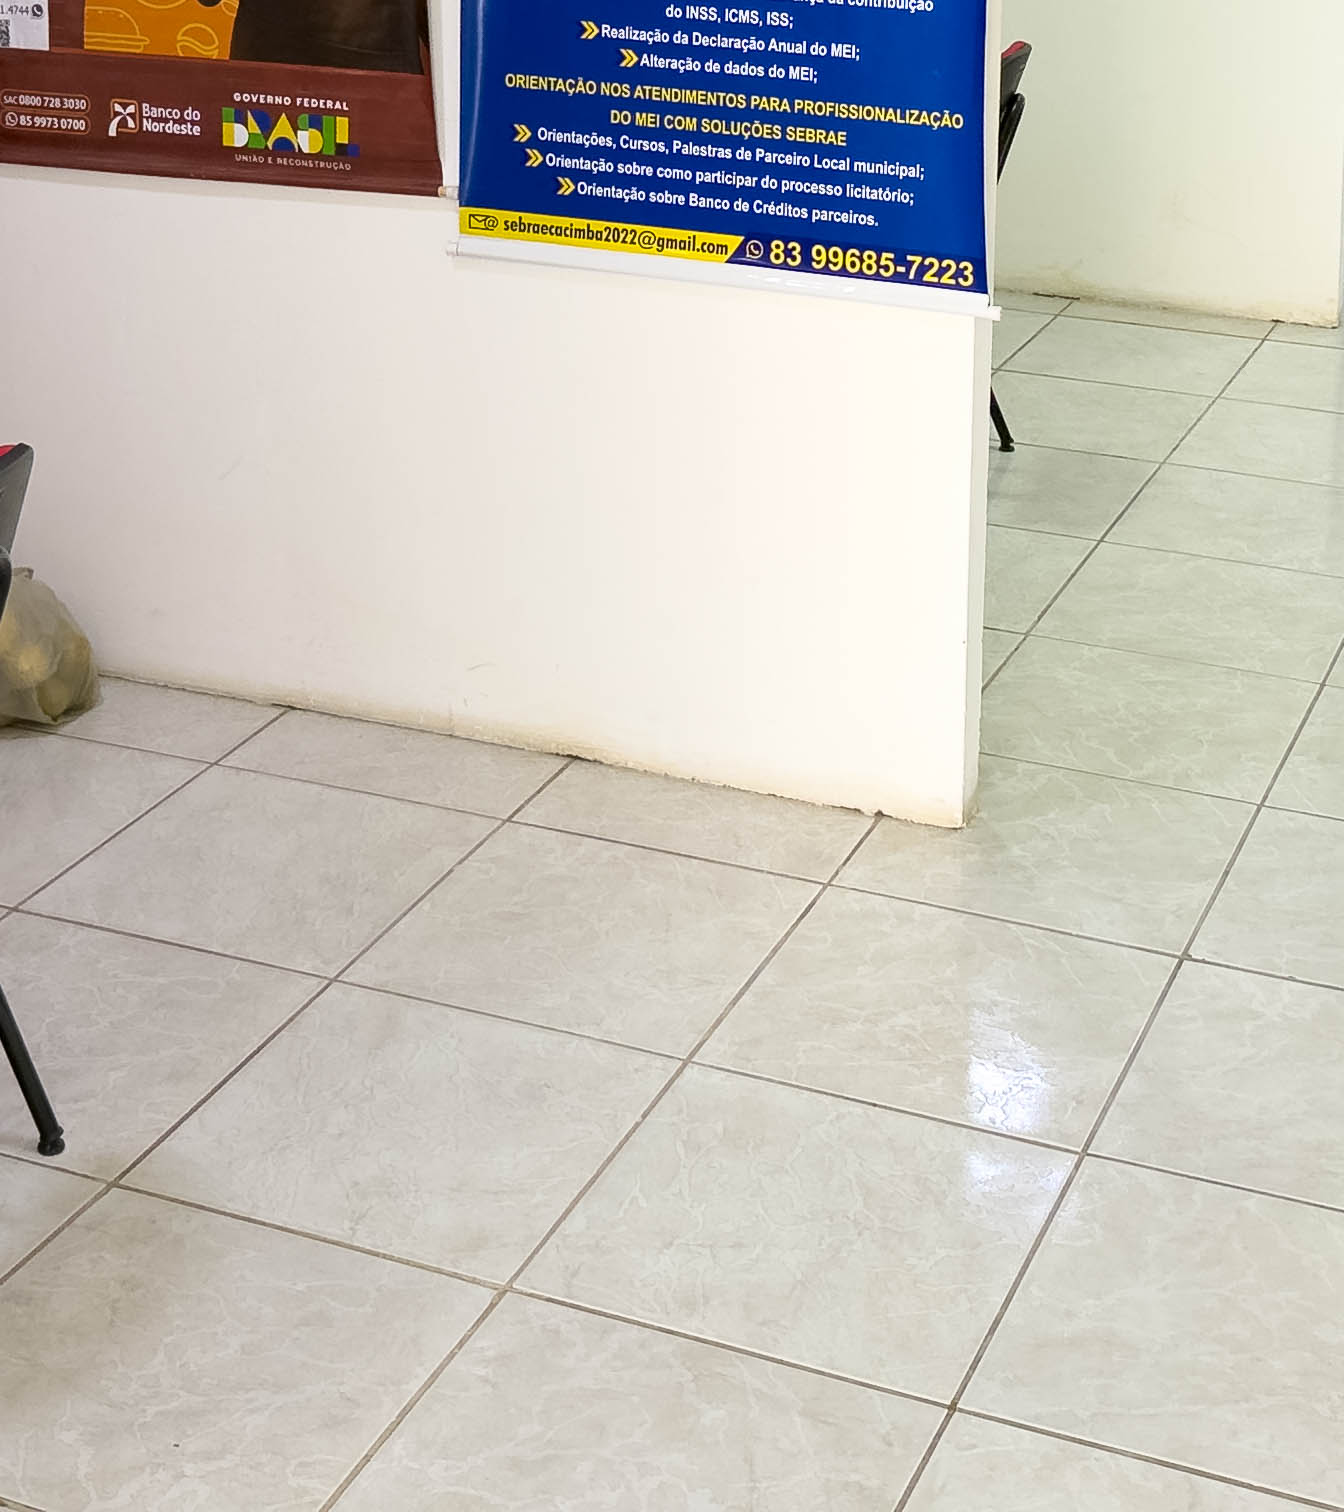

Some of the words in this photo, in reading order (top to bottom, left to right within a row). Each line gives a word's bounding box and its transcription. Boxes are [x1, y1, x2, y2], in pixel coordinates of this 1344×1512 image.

[666, 4, 682, 18] do
[686, 5, 721, 23] INSS,
[725, 8, 763, 27] ICMS,
[767, 11, 793, 29] ISS;
[601, 24, 670, 45] Realização
[673, 30, 688, 45] da
[692, 32, 765, 54] Declaração
[768, 39, 807, 55] Anual
[810, 41, 827, 56] do
[831, 43, 860, 61] MEI;
[640, 53, 701, 73] Alteração
[704, 59, 720, 73] de
[724, 61, 765, 77] dados
[768, 64, 785, 79] do
[789, 66, 818, 84] MEI;
[3, 95, 18, 105] SAC
[18, 94, 42, 107] 0800
[43, 96, 61, 108] 728
[62, 97, 87, 110] 3030
[142, 103, 181, 120] Banco
[183, 106, 201, 121] do
[233, 92, 292, 106] GOVERNO
[296, 97, 349, 111] FEDERAL
[505, 73, 597, 96] ORIENTAÇÃO
[600, 82, 631, 98] NOS
[633, 85, 747, 109] ATENDIMENTOS
[750, 94, 792, 113] PARA
[794, 98, 964, 130] PROFISSIONALIZAÇÃO
[19, 115, 33, 127] 85
[33, 116, 58, 129] 9973
[60, 118, 86, 130] 0700
[142, 120, 201, 136] Nordeste
[610, 109, 631, 125] DO
[635, 112, 660, 128] MEI
[664, 115, 697, 132] COM
[701, 118, 782, 140] SOLUÇÕES
[786, 126, 847, 146] SEBRAE
[234, 154, 265, 164] UNIÃO
[267, 156, 273, 164] E
[276, 157, 352, 170] RECONSTRUÇÃO
[537, 127, 616, 149] Orientações,
[619, 135, 669, 155] Cursos,
[672, 140, 732, 159] Palestras
[735, 146, 752, 161] de
[755, 147, 811, 167] Parceiro
[813, 154, 850, 172] Local
[853, 160, 925, 181] municipal;
[545, 152, 614, 174] Orientação
[617, 160, 654, 176] sobre
[656, 166, 692, 181] como
[695, 169, 758, 189] participar
[761, 174, 778, 190] do
[781, 179, 843, 197] processo
[846, 181, 914, 206] licitatório;
[577, 181, 646, 203] Orientação
[649, 189, 686, 206] sobre
[689, 193, 730, 210] Banco
[733, 197, 750, 213] de
[753, 199, 808, 219] Créditos
[811, 209, 879, 227] parceiros.
[503, 216, 729, 256] sebraecacimba2022@gmail.com
[769, 239, 802, 267] 83
[811, 244, 974, 287] 99685-7223
